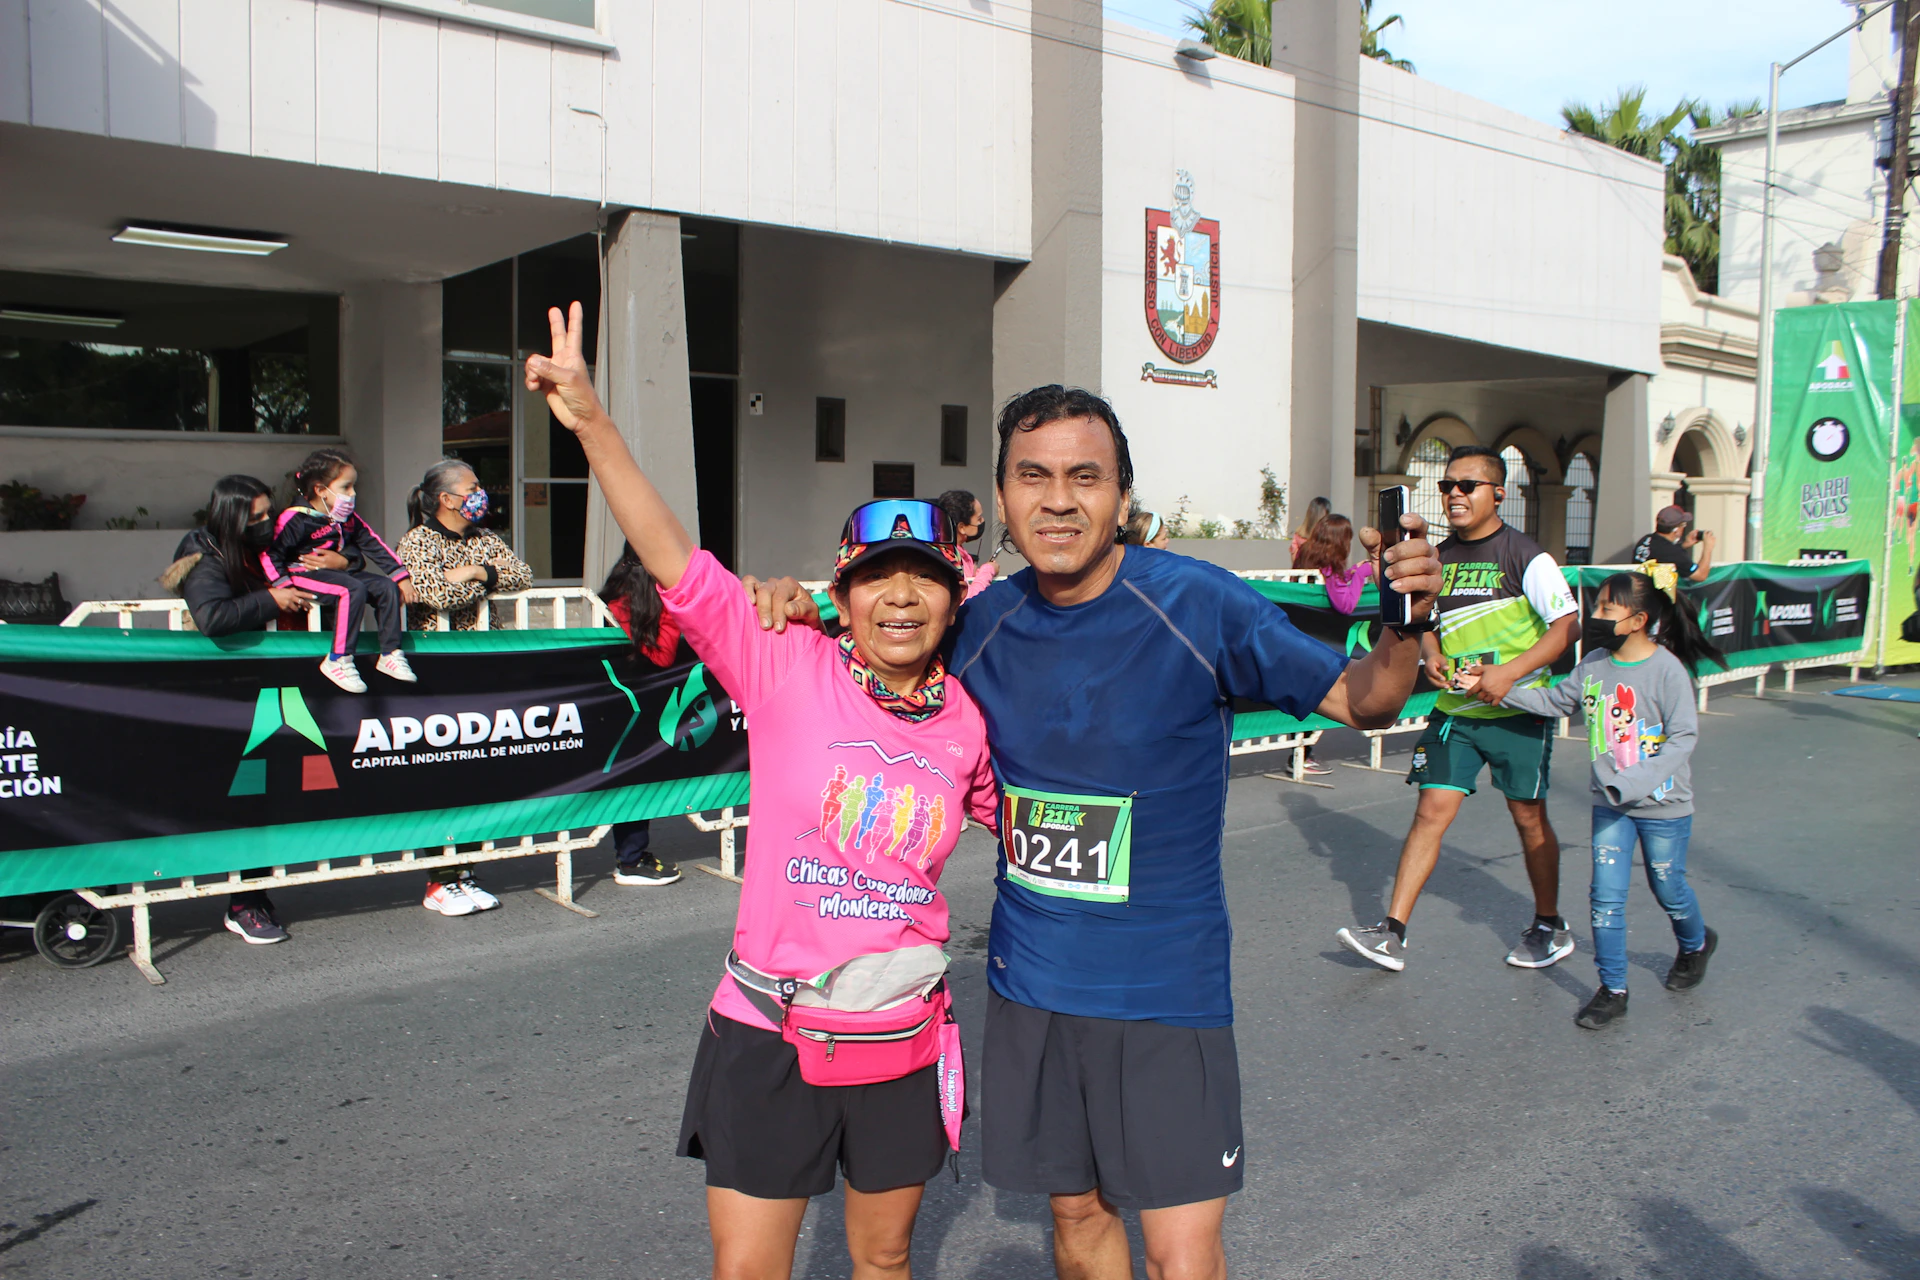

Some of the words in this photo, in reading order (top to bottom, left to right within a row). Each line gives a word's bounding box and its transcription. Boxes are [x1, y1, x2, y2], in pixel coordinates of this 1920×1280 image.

[1147, 229, 1157, 310] PROGRESO
[1210, 241, 1219, 309] JUSTICIA
[1150, 317, 1167, 346] CON
[1209, 318, 1219, 327] Y
[1168, 332, 1213, 360] LIBERTAD
[1801, 476, 1849, 503] BARRI
[1458, 562, 1498, 570] CARRERA
[1450, 588, 1493, 596] APODACA
[352, 702, 584, 754] APODACA
[0, 753, 39, 774] TE
[351, 755, 409, 769] CAPITAL
[411, 748, 488, 765] INDUSTRIAL
[490, 747, 506, 757] DE
[509, 741, 551, 755] NUEVO
[553, 737, 583, 751] LEÓN
[1045, 803, 1080, 812] CARRERA
[1040, 822, 1076, 832] APODACA
[1012, 828, 1109, 879] 0241
[786, 856, 849, 887] Chicas
[819, 892, 915, 926] Monterre
[947, 1069, 960, 1112] Monterrey
